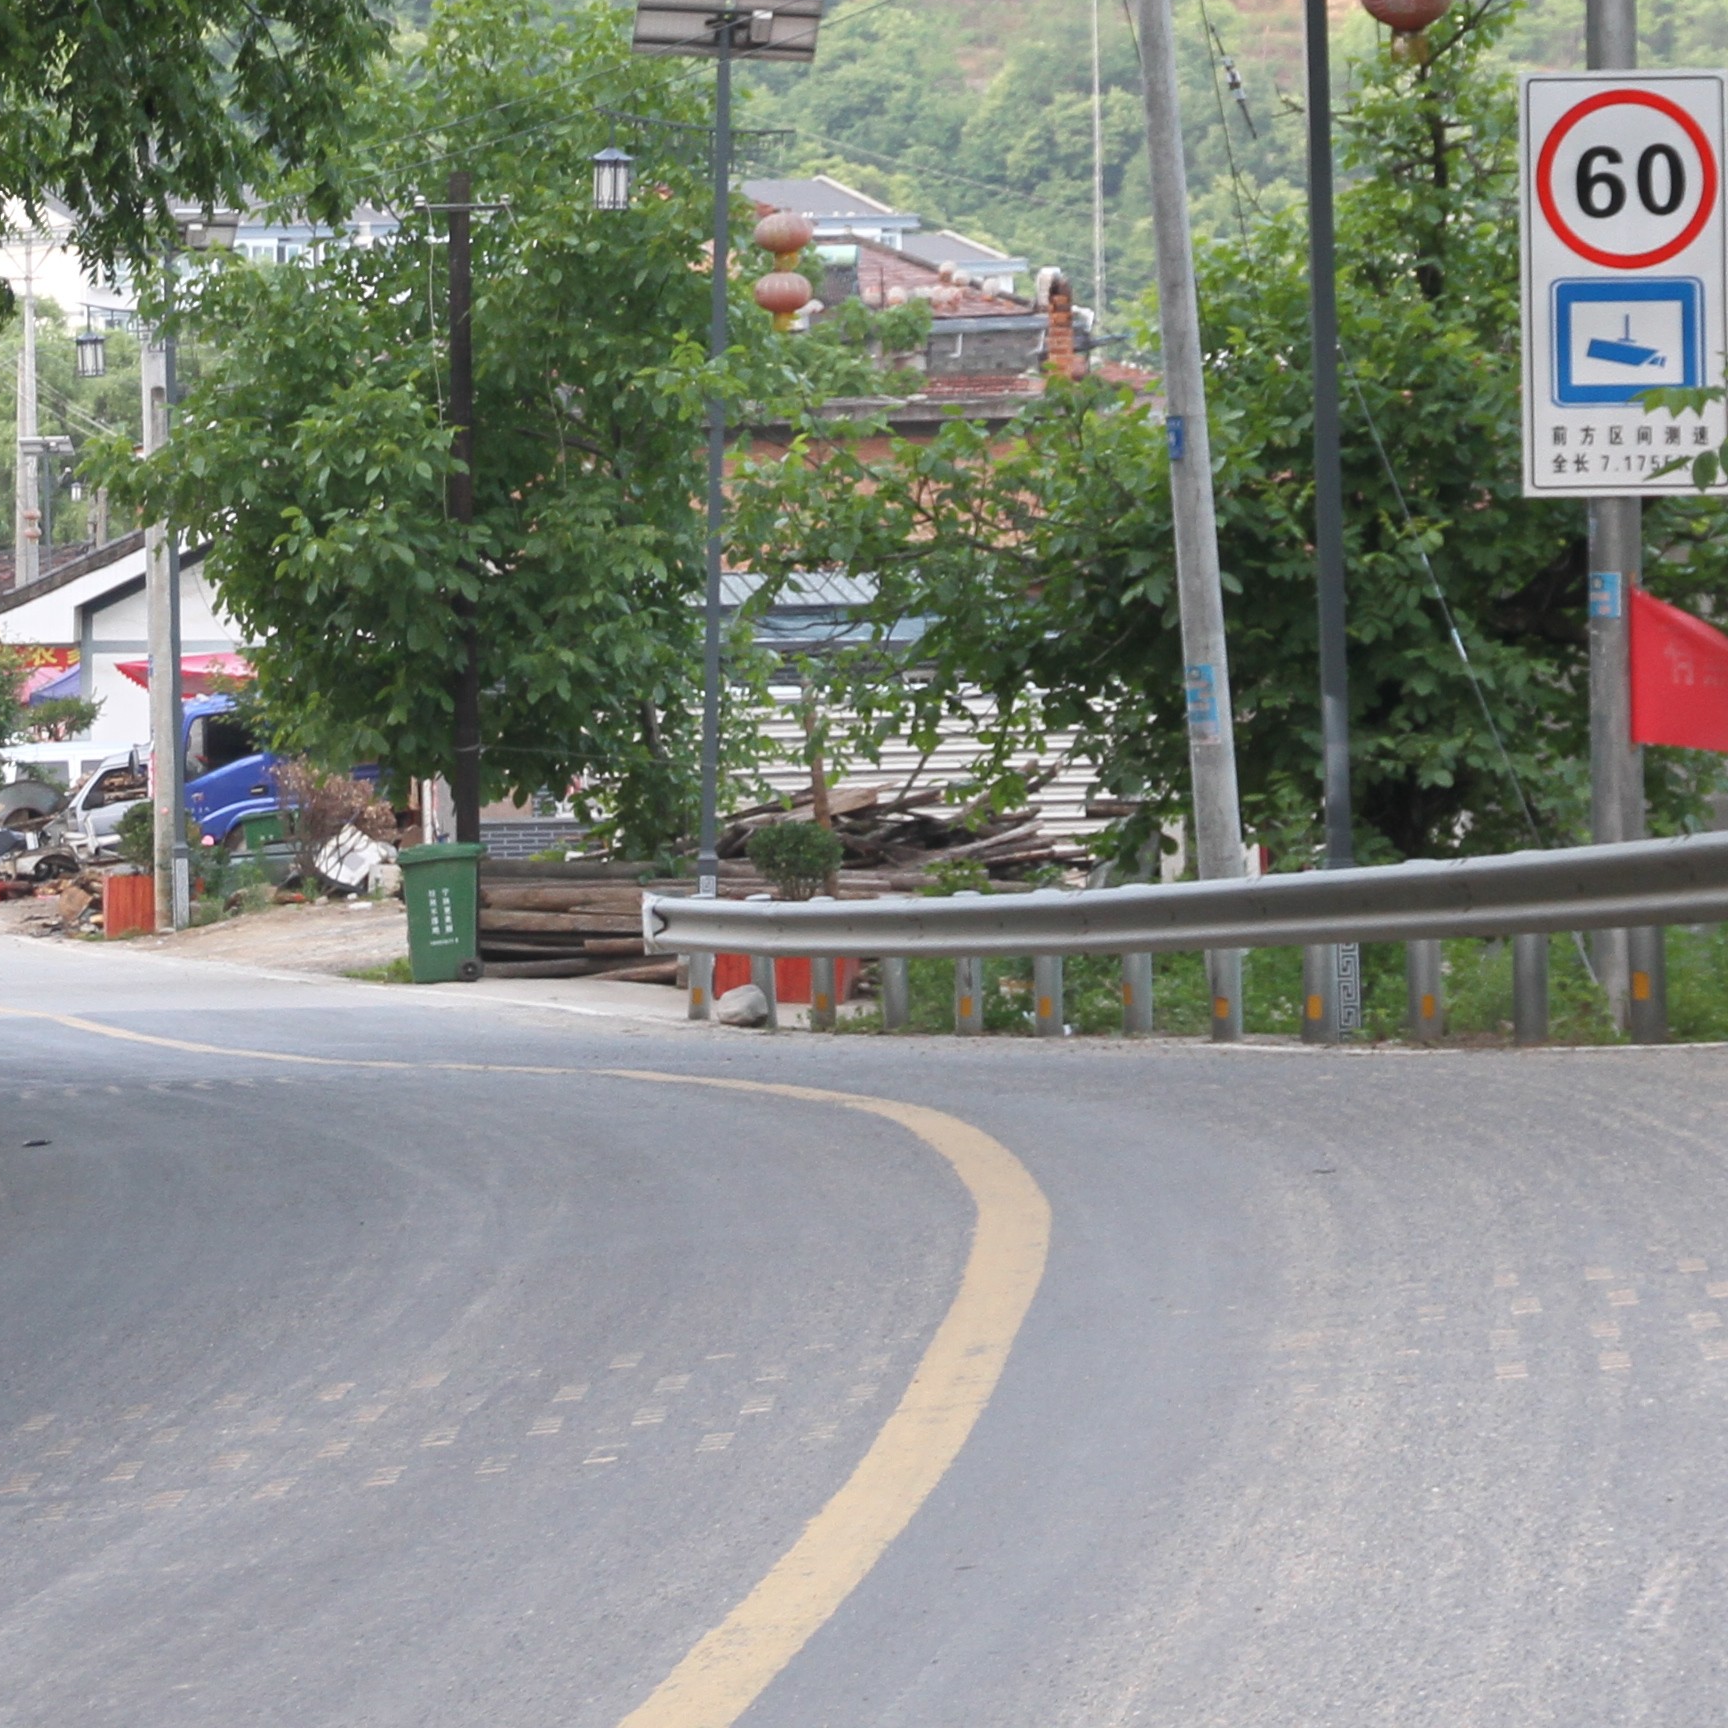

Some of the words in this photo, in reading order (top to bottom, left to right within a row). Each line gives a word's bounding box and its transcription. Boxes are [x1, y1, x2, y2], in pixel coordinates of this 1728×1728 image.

[1576, 143, 1686, 218] 60
[1552, 426, 1709, 446] 前方区间测速
